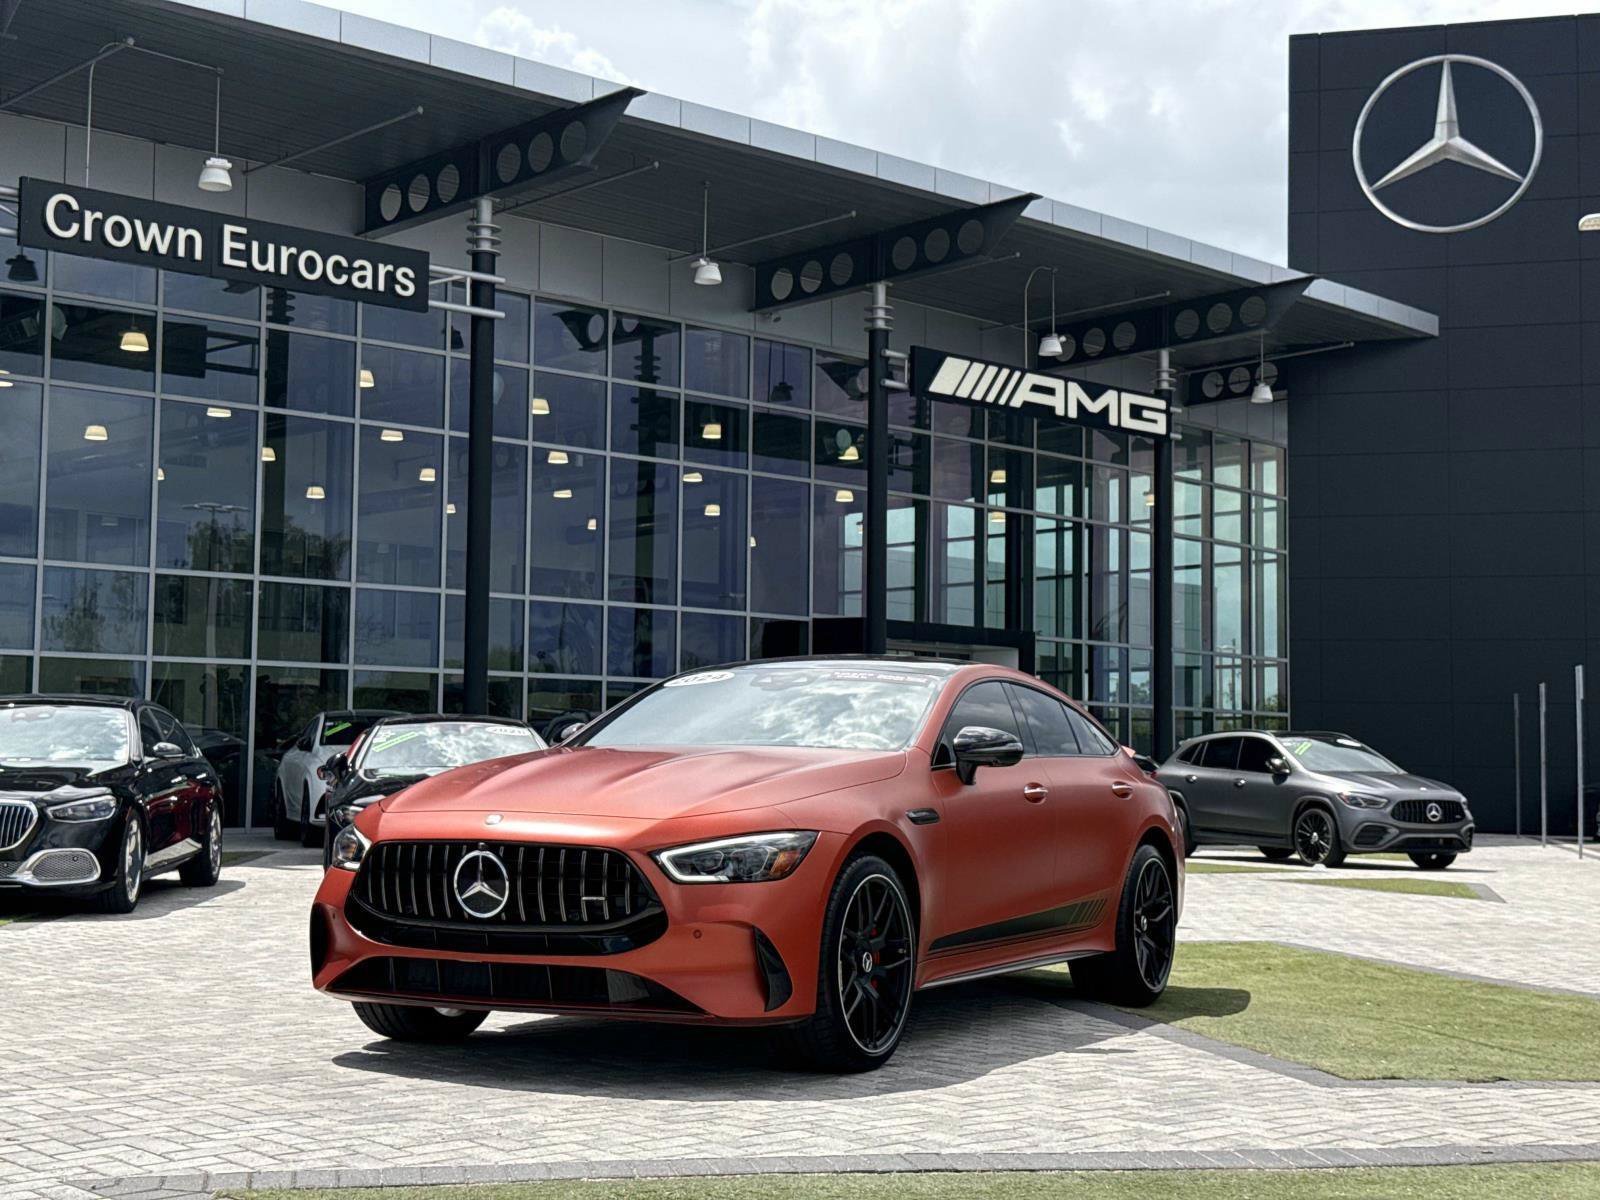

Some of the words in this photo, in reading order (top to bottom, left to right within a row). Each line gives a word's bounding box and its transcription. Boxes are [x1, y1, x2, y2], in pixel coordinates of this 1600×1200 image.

[45, 193, 202, 261] Crown
[222, 224, 416, 297] Eurocars
[1009, 373, 1167, 435] AMG
